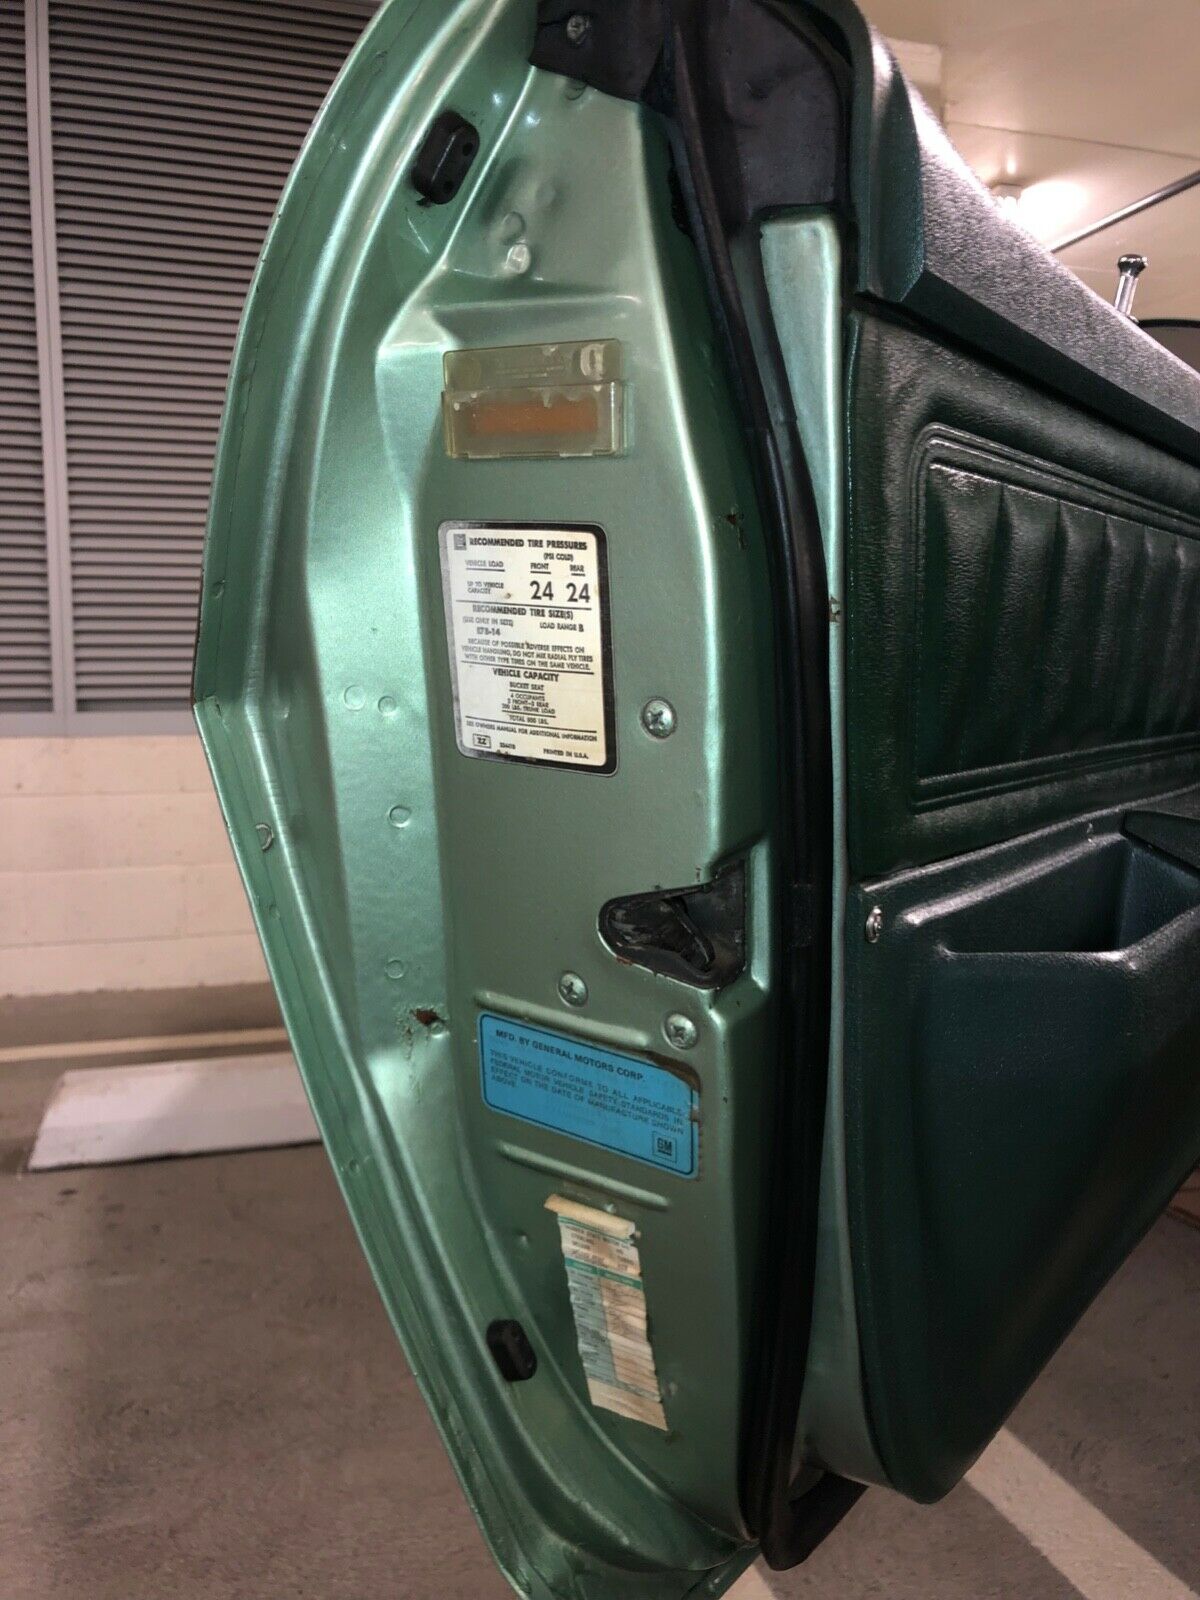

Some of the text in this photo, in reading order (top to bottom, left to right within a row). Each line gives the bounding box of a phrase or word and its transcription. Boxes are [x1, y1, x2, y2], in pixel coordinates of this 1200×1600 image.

[470, 538, 587, 551] RECOMMENDED TIRE PRESSURES
[488, 560, 504, 569] LOAD
[570, 564, 584, 572] REAR
[530, 580, 554, 601] 24
[566, 582, 590, 603] 24
[472, 604, 574, 620] RECOMMENDED TIRE SIZE(S)
[540, 622, 555, 630] LOAD
[557, 623, 577, 632] RANGE
[468, 638, 490, 646] BECAUSE
[500, 640, 524, 649] POSSIBLE
[526, 642, 550, 652] ADVERSE
[462, 645, 482, 653] VEHICLE
[522, 650, 535, 658] NOT
[547, 653, 567, 661] RADIAL
[578, 655, 593, 663] TIRES
[478, 654, 496, 662] OTHER
[498, 656, 510, 664] TYPE
[511, 657, 526, 666] TIRES
[526, 659, 536, 667] ON
[538, 660, 548, 668] THE
[550, 661, 566, 669] SAME
[493, 668, 559, 682] VEHICLE CAPACITY
[509, 682, 530, 690] BUCKET
[515, 693, 545, 702] OCCUPANTS
[508, 714, 526, 722] TOTAL
[496, 724, 518, 734] MANUAL
[529, 729, 560, 740] ADDITIONAL
[562, 733, 598, 742] INFORMATION
[543, 748, 564, 757] PRINTED
[496, 1030, 646, 1082] MFD. BY GENERAL MOTORS CORP.
[490, 1049, 684, 1116] THIS VEHICLE CONFORMS TO ALL APPLICABLE
[490, 1057, 520, 1073] FEDERAL
[524, 1069, 550, 1082] MOTOR
[554, 1079, 584, 1094] VEHICLE
[588, 1090, 618, 1104] SAFETY
[621, 1100, 670, 1122] STANDARDS
[490, 1066, 684, 1136] EFFECT ON THE DATE OF MANUFACTURE SHOWN
[657, 1137, 672, 1153] GM
